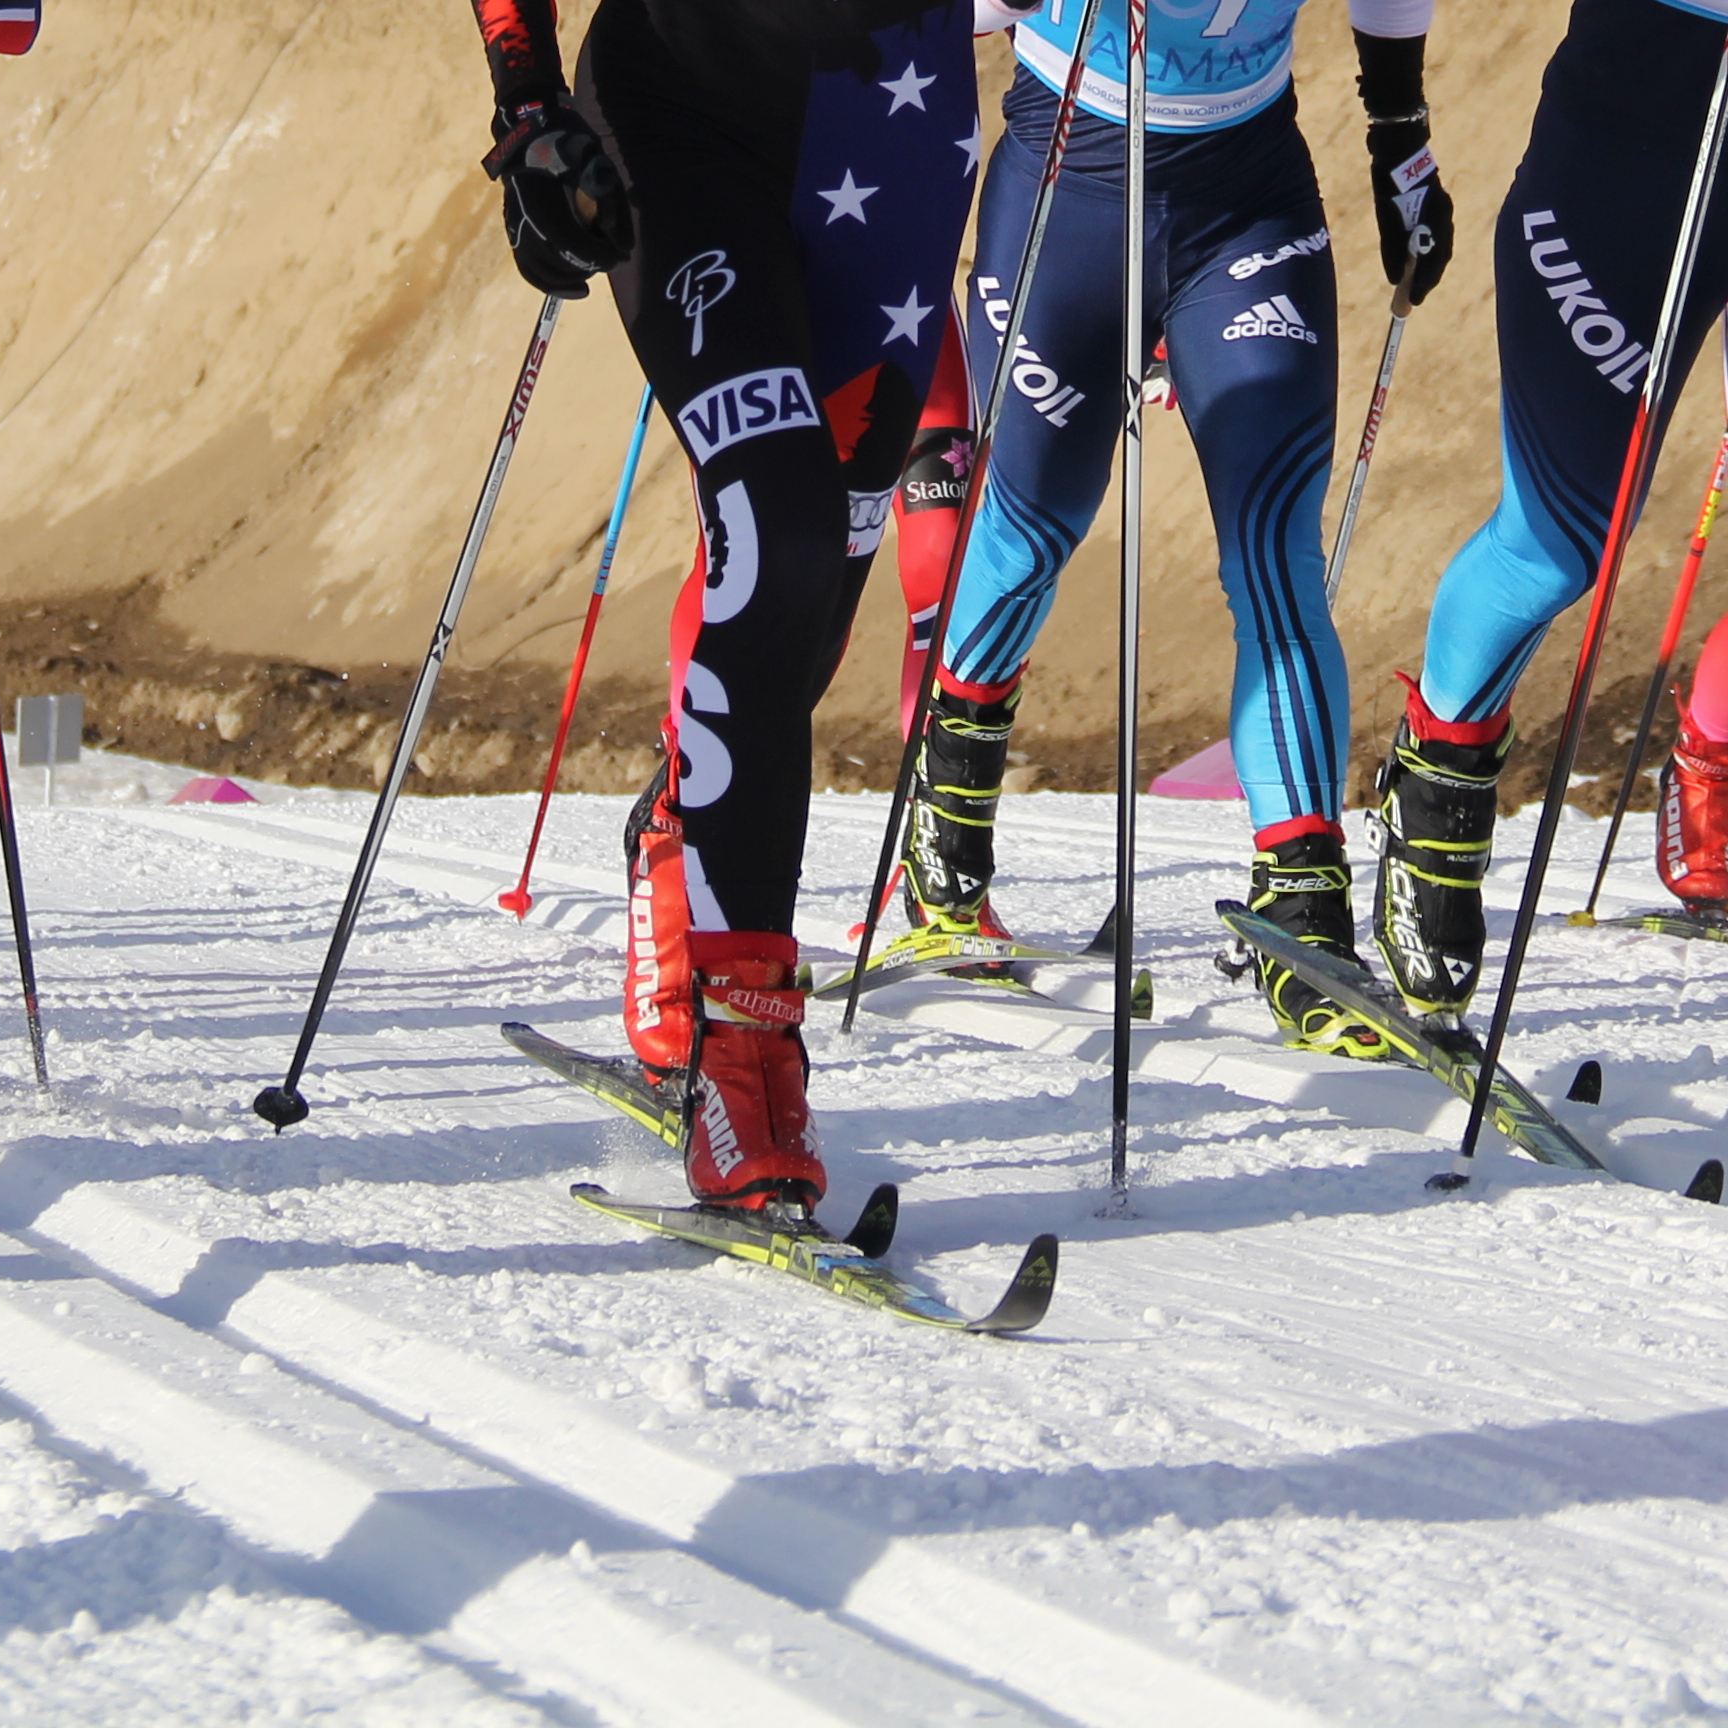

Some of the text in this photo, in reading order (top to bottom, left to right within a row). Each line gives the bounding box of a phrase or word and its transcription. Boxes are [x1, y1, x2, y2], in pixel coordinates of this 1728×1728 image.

[1082, 80, 1128, 109] NORDIC
[1522, 209, 1652, 395] LUKOIL
[1222, 320, 1319, 346] adidas
[683, 385, 813, 451] VISA
[726, 988, 806, 1024] alpina
